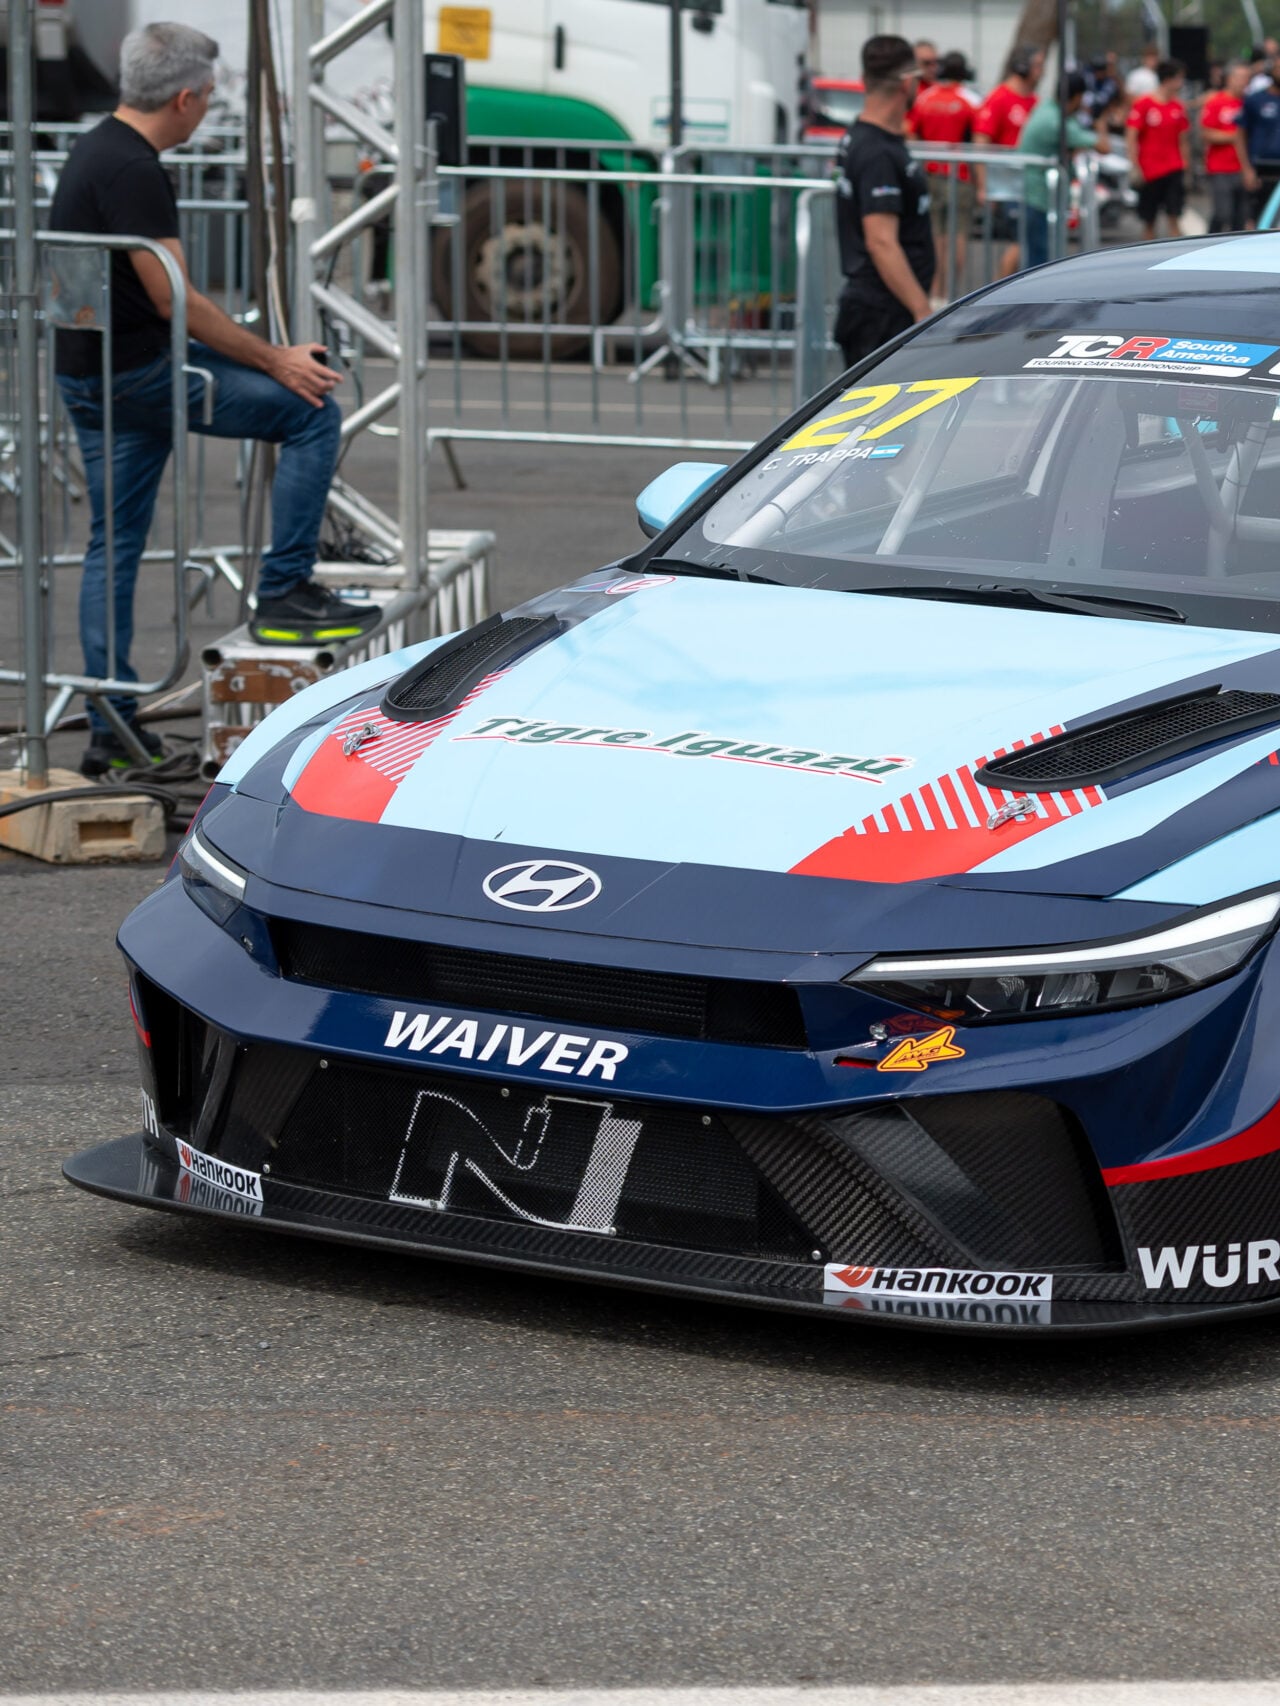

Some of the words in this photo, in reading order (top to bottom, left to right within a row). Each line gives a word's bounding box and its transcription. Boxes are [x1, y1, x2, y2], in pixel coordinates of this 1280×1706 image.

[1047, 335, 1171, 361] TCR
[1155, 348, 1252, 365] America
[1171, 340, 1237, 354] South
[1030, 358, 1082, 368] TOURING
[1083, 360, 1109, 369] CAR
[1109, 361, 1202, 373] CHAMPIONSHIP
[780, 376, 982, 452] 27
[786, 446, 874, 468] TRAPPA
[469, 717, 650, 746] Tigre
[658, 731, 910, 776] Iguazú
[383, 1010, 631, 1082] WAIVER
